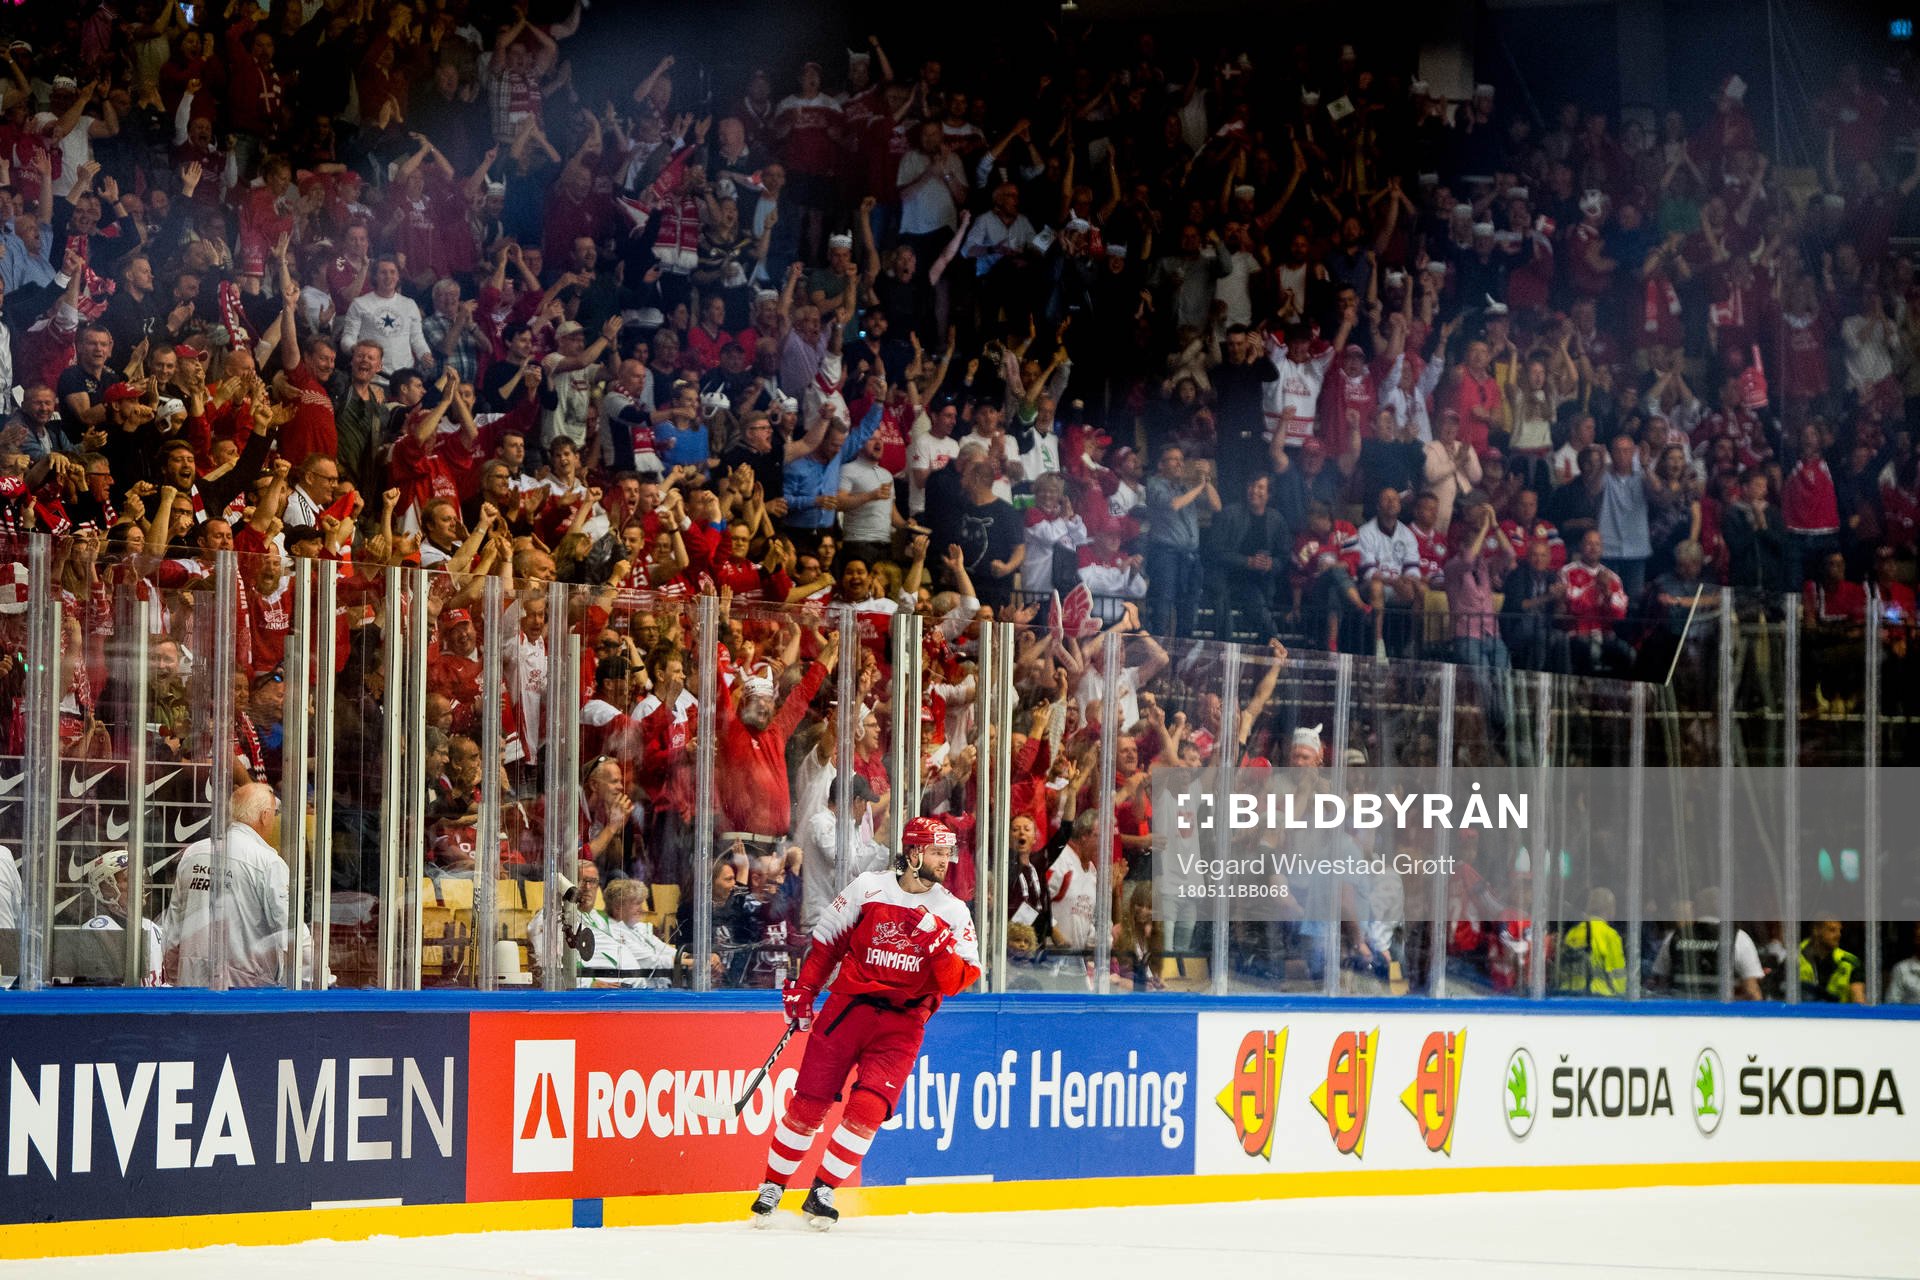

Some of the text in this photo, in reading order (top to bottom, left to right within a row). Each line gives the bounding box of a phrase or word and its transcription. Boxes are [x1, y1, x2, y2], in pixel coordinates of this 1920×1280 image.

[865, 946, 924, 973] DANMARK
[8, 1053, 455, 1181] NIVEA MEN
[587, 1066, 824, 1139] ROCKWOO
[972, 1049, 1018, 1130] of
[1029, 1049, 1188, 1149] Herning
[1552, 1054, 1674, 1119] ŠKODA
[1739, 1054, 1905, 1117] ŠKODA
